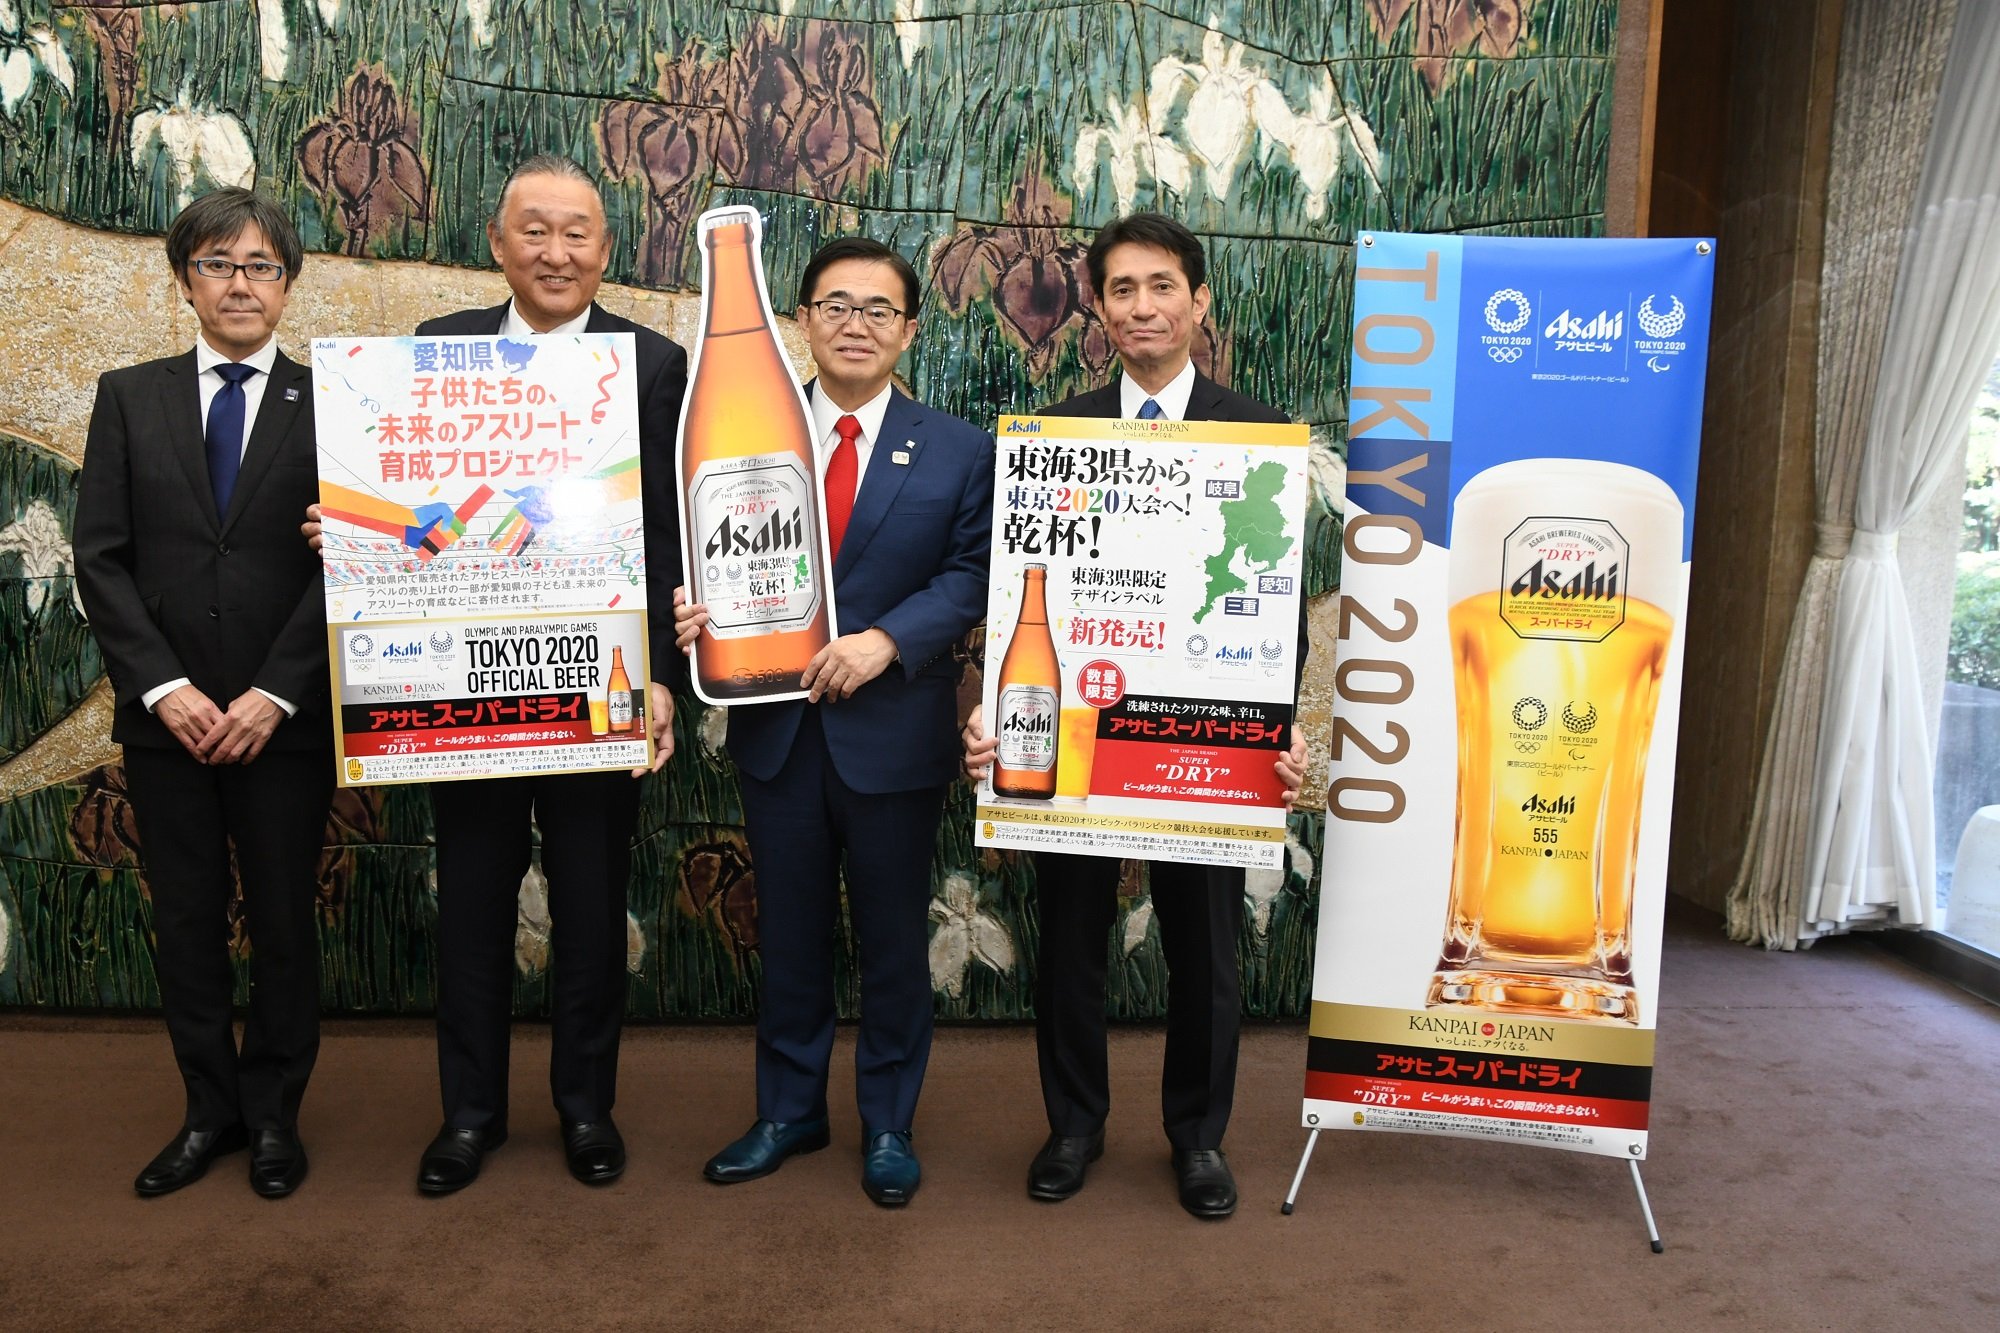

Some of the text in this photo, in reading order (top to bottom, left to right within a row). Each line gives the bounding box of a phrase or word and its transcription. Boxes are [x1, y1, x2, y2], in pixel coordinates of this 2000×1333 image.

[1545, 308, 1624, 341] Asahi
[315, 341, 337, 350] Asahi
[1481, 335, 1532, 346] TOKYO 2020
[1555, 340, 1613, 352] アサヒビール
[1634, 340, 1686, 350] TOKYO 2020
[414, 342, 494, 374] 愛知県
[377, 411, 581, 446] 未来のアスリート
[1006, 419, 1041, 433] Asahi
[1112, 421, 1190, 432] KANPAI JAPAN
[379, 448, 583, 484] 育成プロジェクト
[740, 459, 757, 468] 辛口
[1004, 445, 1191, 487] 東海3県から
[1207, 480, 1239, 498] 岐阜
[1005, 485, 1191, 516] 東京2020大会へ!
[705, 505, 802, 560] Asahi
[1002, 513, 1101, 559] 乾杯!
[1327, 250, 1440, 825] TOKYO 2020
[1528, 529, 1605, 552] ASAHI BREWERIES LIMITED
[749, 577, 786, 597] 乾杯!
[1070, 567, 1167, 590] 東海3県限定
[1260, 576, 1291, 594] 愛知
[1510, 558, 1618, 602] Asahi
[367, 592, 544, 610] アスリートの育成などに寄付されます。
[732, 596, 787, 611] スーパードライ
[1070, 589, 1164, 606] デザインラベル
[746, 607, 774, 619] 生ビール
[1227, 598, 1258, 616] 三重
[465, 622, 598, 638] OLYMPIC AND PARALYMPIC GAMES
[1530, 617, 1592, 630] スーパードライ
[1067, 616, 1165, 651] 新発売!
[382, 641, 423, 658] Asahi
[465, 634, 599, 668] TOKYO 2020
[1216, 645, 1252, 660] Asahi
[467, 665, 600, 694] OFFICIAL BEER
[1085, 669, 1118, 685] 数量
[363, 683, 445, 695] KANPAI JAPAN
[1085, 685, 1117, 701] 限定
[369, 695, 582, 731] アサヒスーパードライ
[611, 700, 630, 709] Asahi
[1126, 699, 1267, 720] 洗練されたクリアな味、辛口。
[1004, 711, 1052, 733] Asahi
[1109, 716, 1283, 743] アサヒスーパードライ
[435, 731, 576, 747] ビールがうまい。この瞬間がたまらない。
[1179, 756, 1209, 765] SUPER
[1507, 760, 1596, 772] 東京2020ゴールドパートナー
[1123, 781, 1262, 801] ビールがうまい。この瞬間がたまらない。
[1521, 793, 1576, 815] Asahi
[1528, 814, 1568, 824] アサヒビール
[1533, 827, 1558, 844] 555
[1501, 845, 1589, 860] KANPAI JAPAN
[1409, 1015, 1554, 1042] KANPAI JAPAN
[1435, 1035, 1530, 1052] いっしょに、アツくなる。
[1376, 1053, 1583, 1090] アサヒスーパードライ
[1371, 1085, 1396, 1093] SUPER
[1421, 1091, 1600, 1118] ビールがうまい。この瞬間がたまらない。
